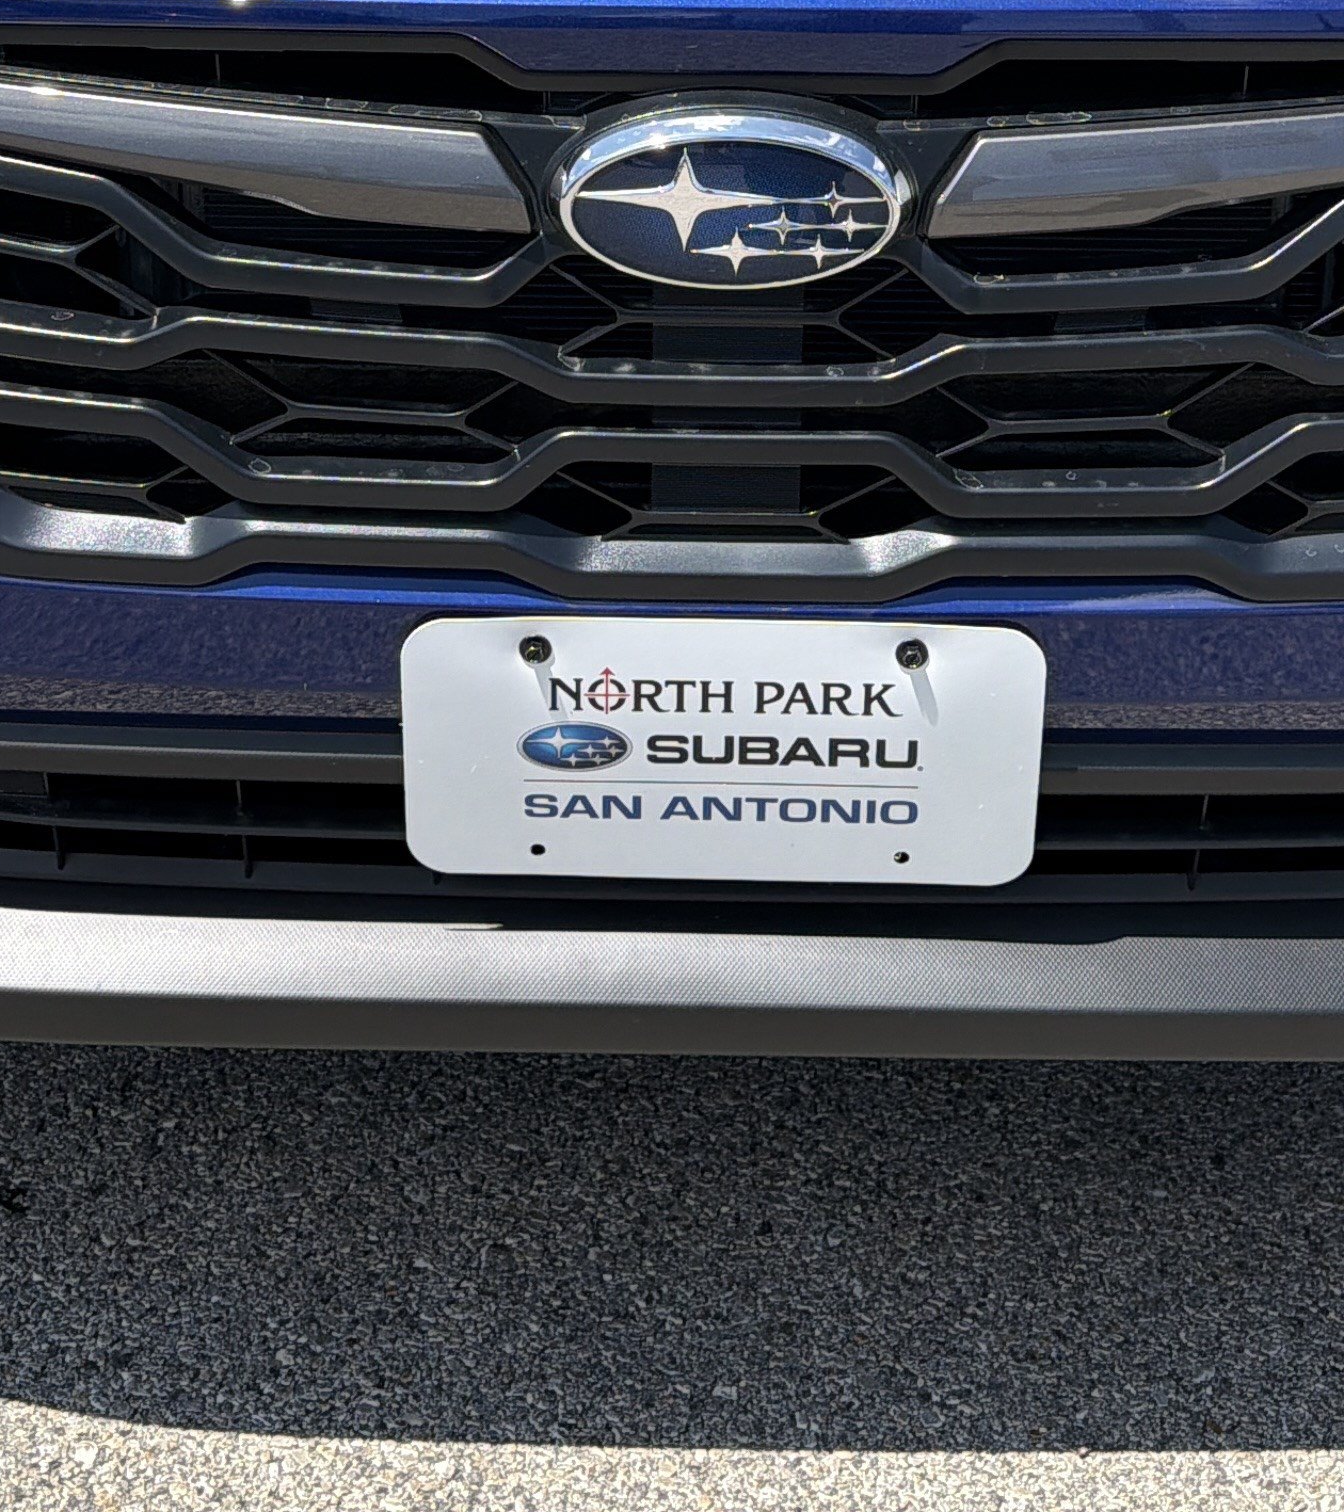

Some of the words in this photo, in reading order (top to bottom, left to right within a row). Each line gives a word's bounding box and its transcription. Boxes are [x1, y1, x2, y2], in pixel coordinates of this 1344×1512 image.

[548, 674, 736, 716] NORTH
[754, 679, 904, 718] PARK
[645, 734, 920, 769] SUBARU
[523, 794, 644, 821] SAN
[660, 796, 920, 826] ANTONIO
